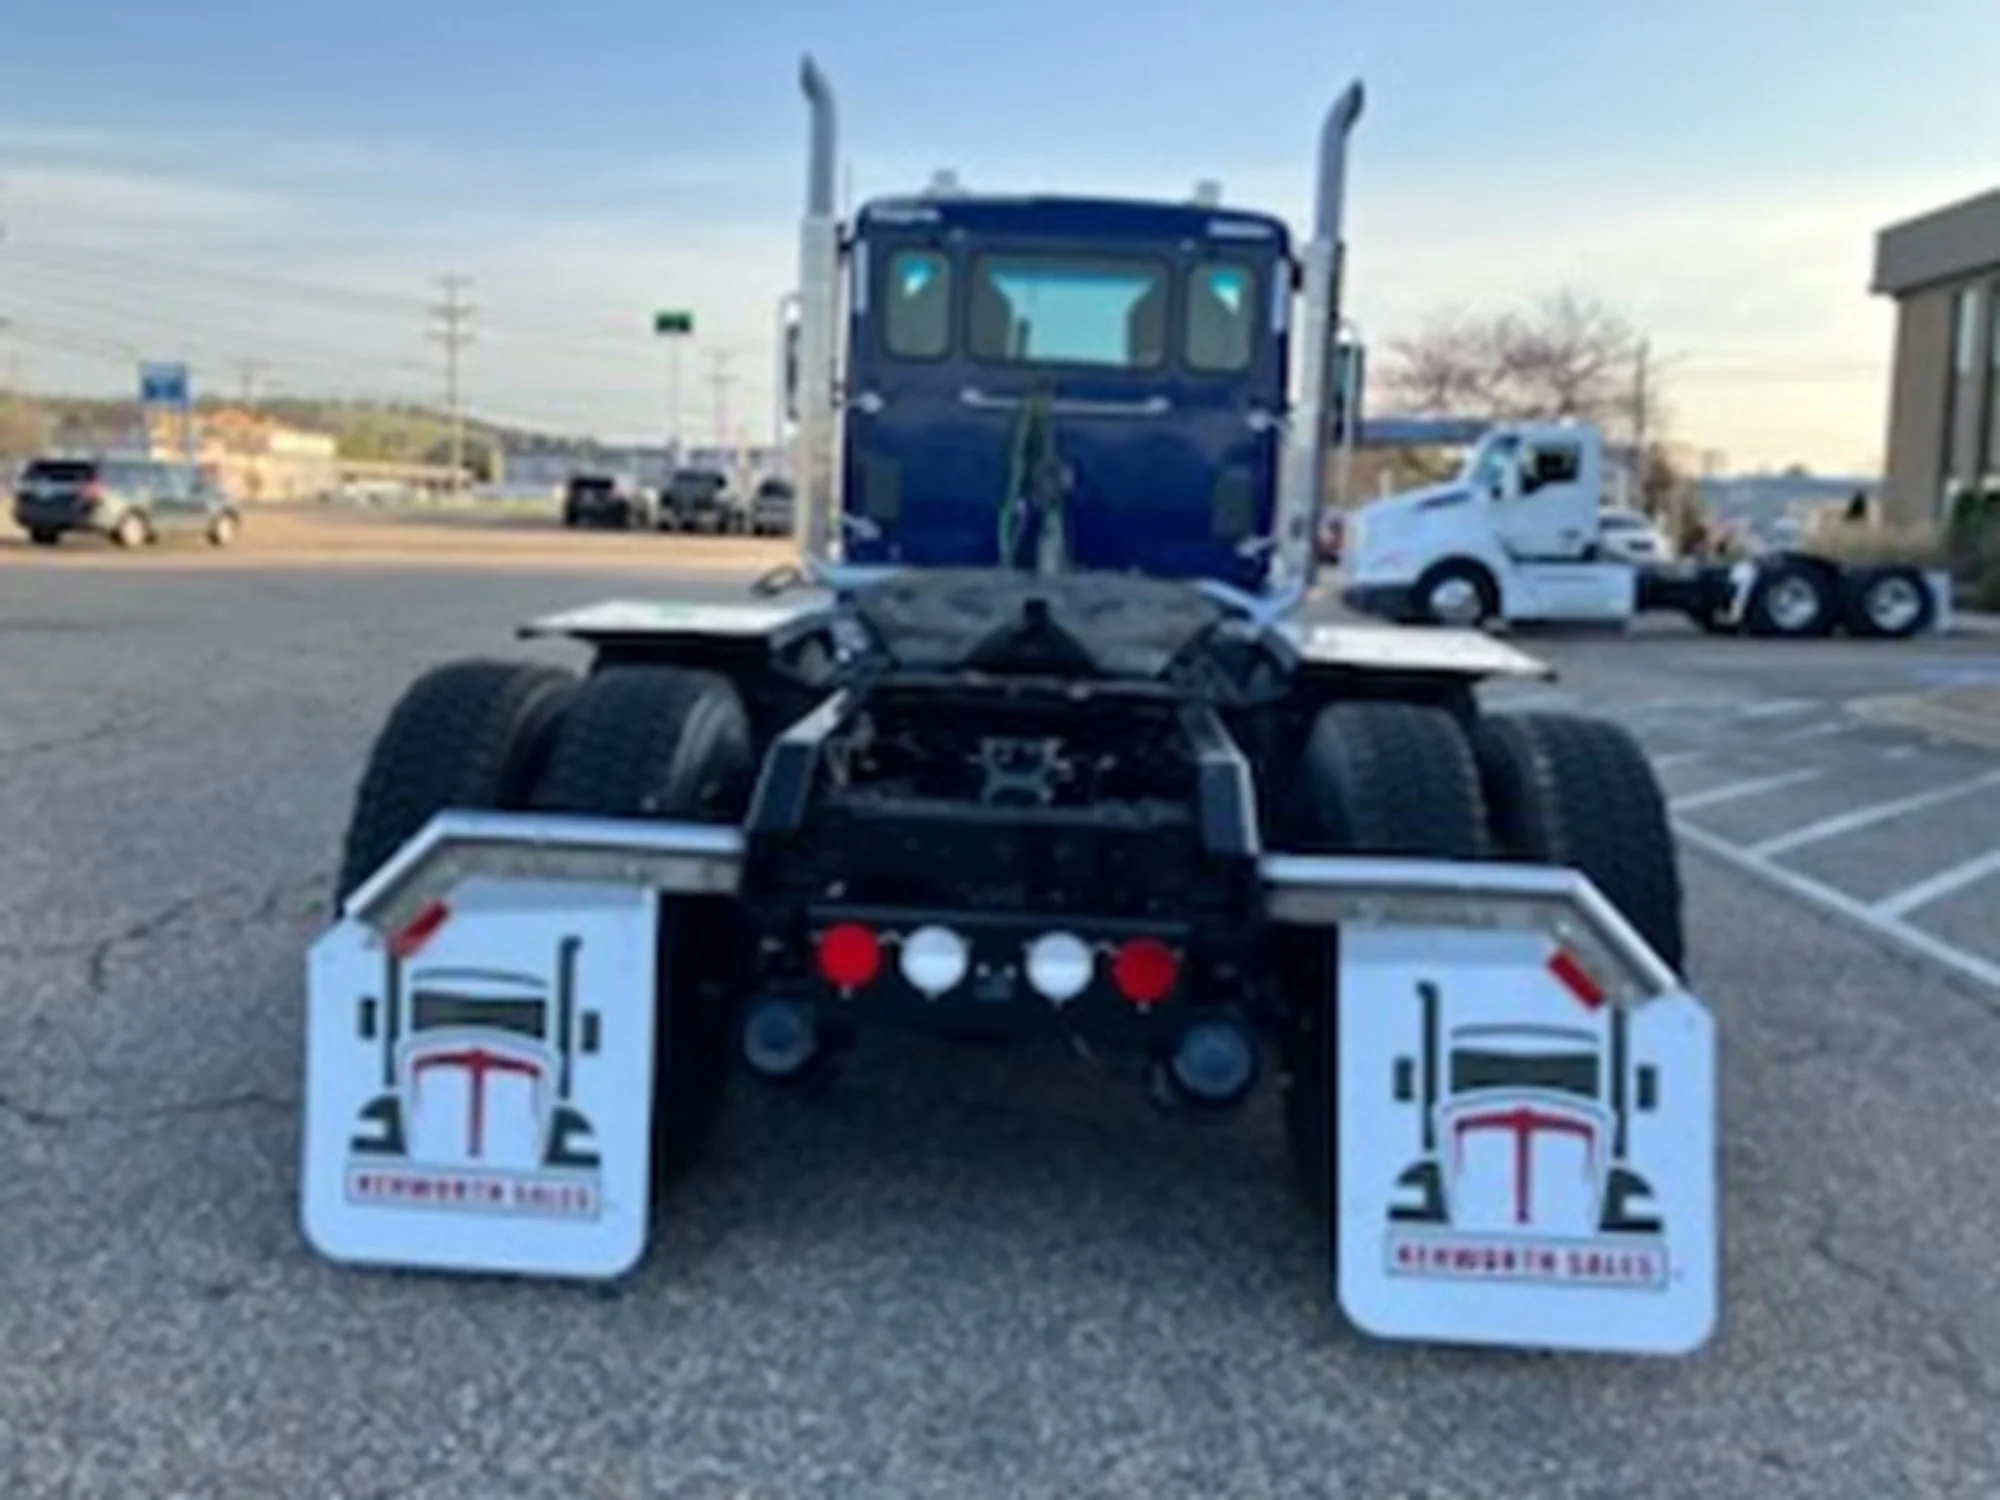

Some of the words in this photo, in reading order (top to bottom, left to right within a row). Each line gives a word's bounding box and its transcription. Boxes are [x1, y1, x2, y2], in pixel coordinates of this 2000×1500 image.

[356, 1174, 504, 1202] KENWORTH
[1397, 1244, 1557, 1271] KENWORTH
[1567, 1250, 1655, 1278] SALES
